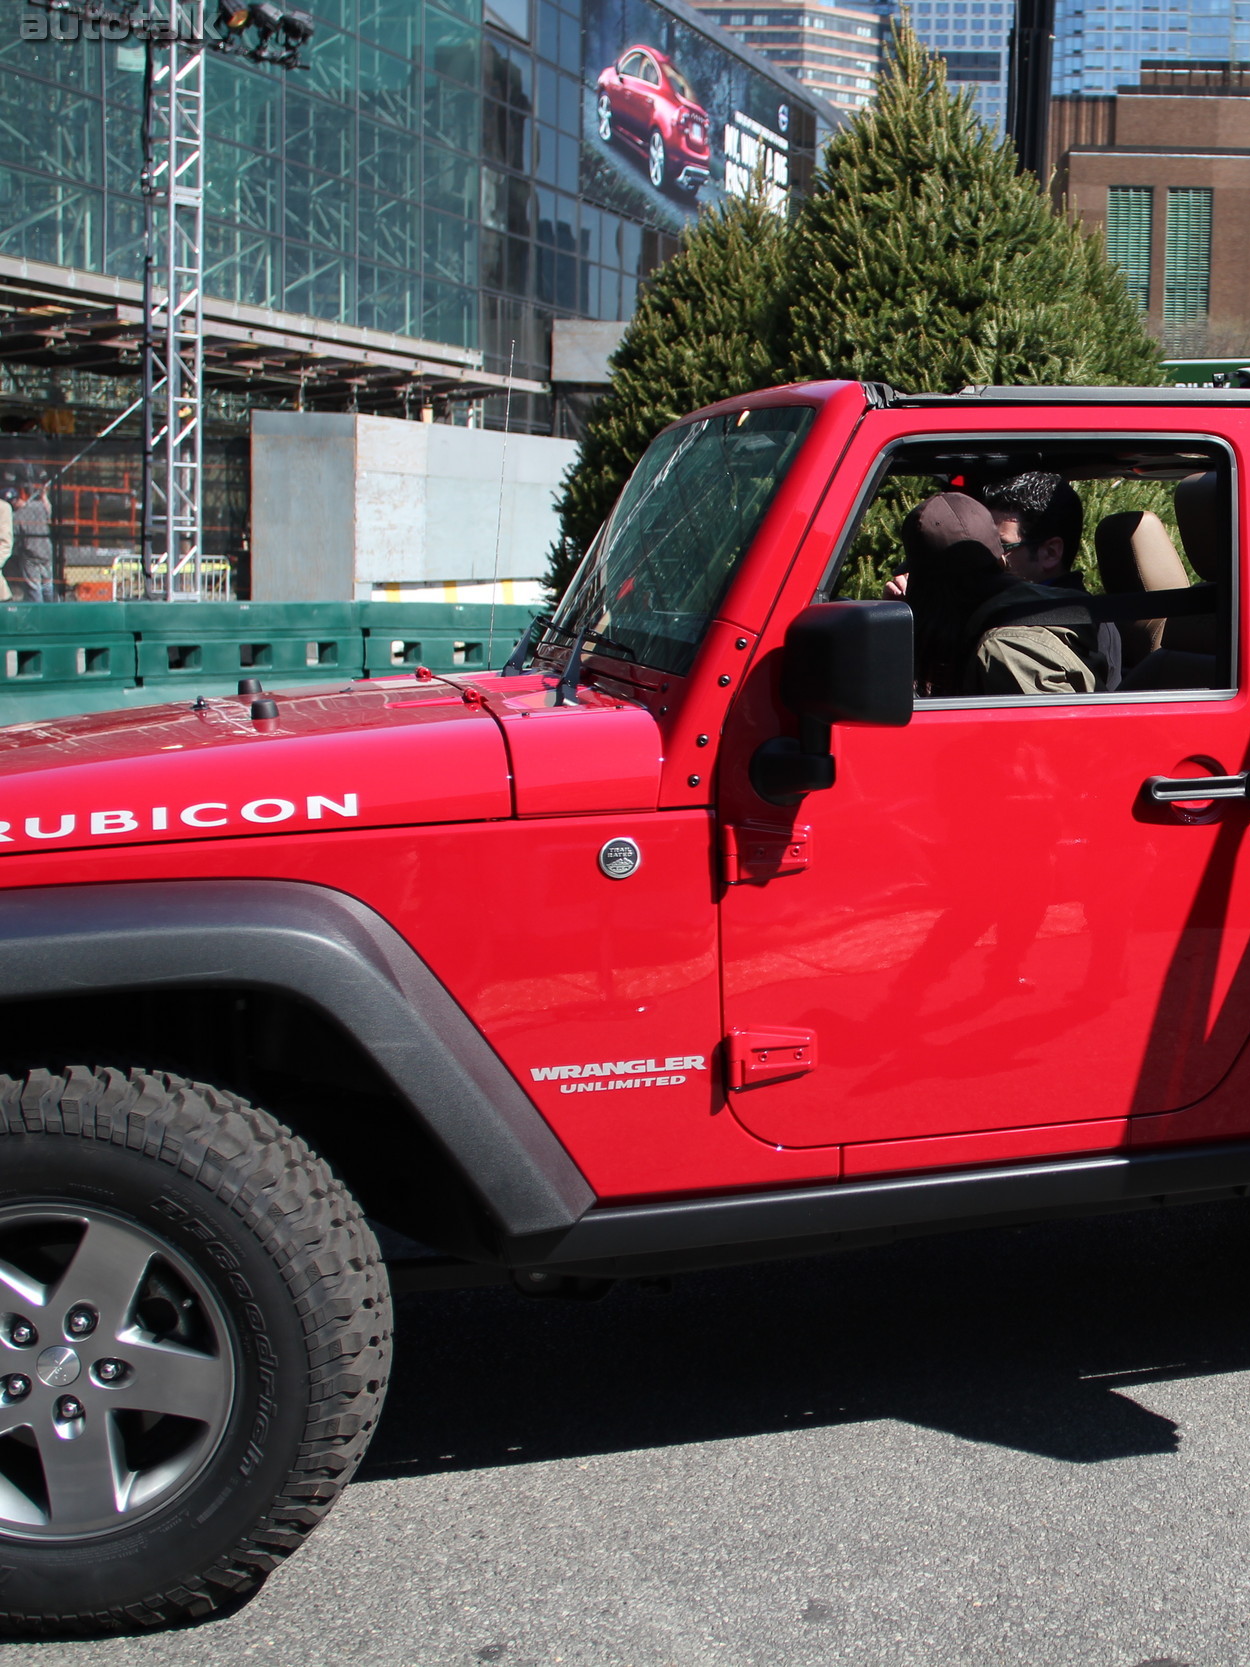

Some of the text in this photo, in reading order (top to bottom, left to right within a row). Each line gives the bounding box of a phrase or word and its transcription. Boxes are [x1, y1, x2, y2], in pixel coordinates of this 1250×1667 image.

[530, 1055, 707, 1082] WRANGLER
[560, 1075, 686, 1094] UNLIMITED
[151, 1194, 279, 1478] BFGoodrich
